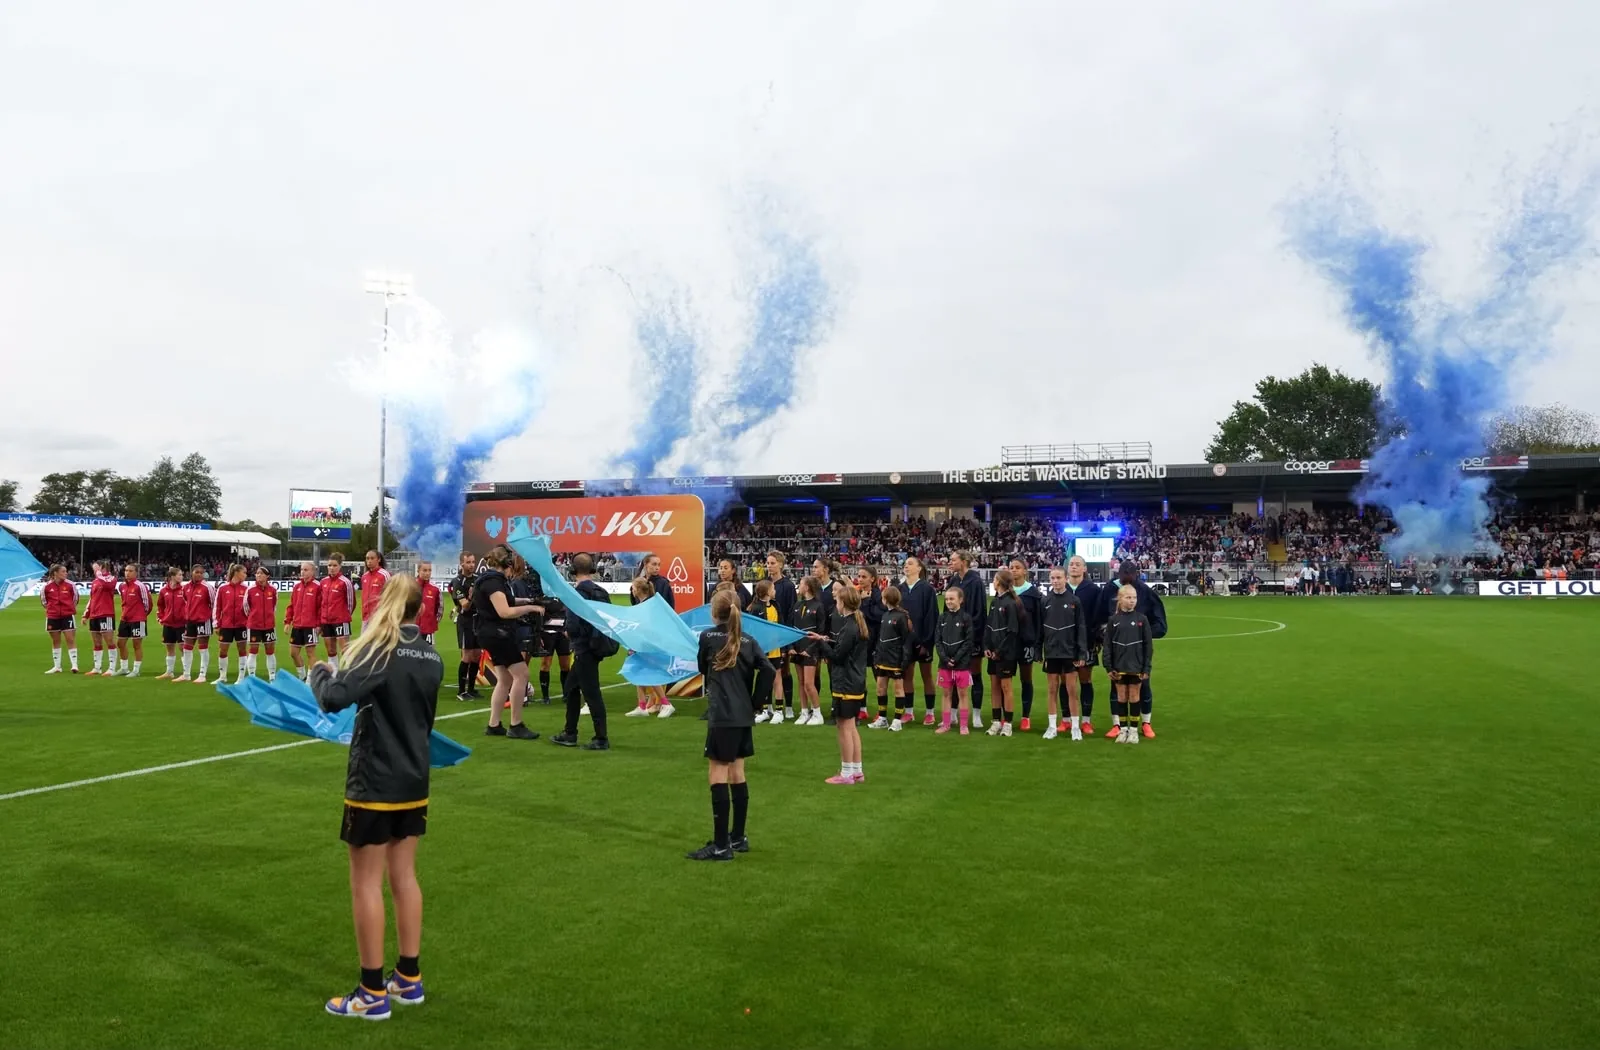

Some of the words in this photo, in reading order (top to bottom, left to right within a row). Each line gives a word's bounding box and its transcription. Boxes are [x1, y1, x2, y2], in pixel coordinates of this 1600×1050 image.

[941, 470, 968, 484] THE
[973, 468, 1030, 482] GEORGE
[1035, 465, 1110, 481] WAKELING
[1116, 463, 1167, 479] STAND
[74, 517, 120, 526] SOLICITORS
[507, 515, 597, 535] BRCLAYS
[601, 510, 677, 537] WSL
[1497, 581, 1547, 595] GET
[68, 620, 73, 628] 7
[100, 622, 107, 630] 10
[132, 628, 140, 637] 15
[197, 625, 205, 634] 14
[335, 626, 343, 635] 17
[266, 632, 275, 641] 20
[308, 634, 313, 643] 2
[426, 634, 431, 643] 4
[396, 648, 424, 659] OFFICIAL
